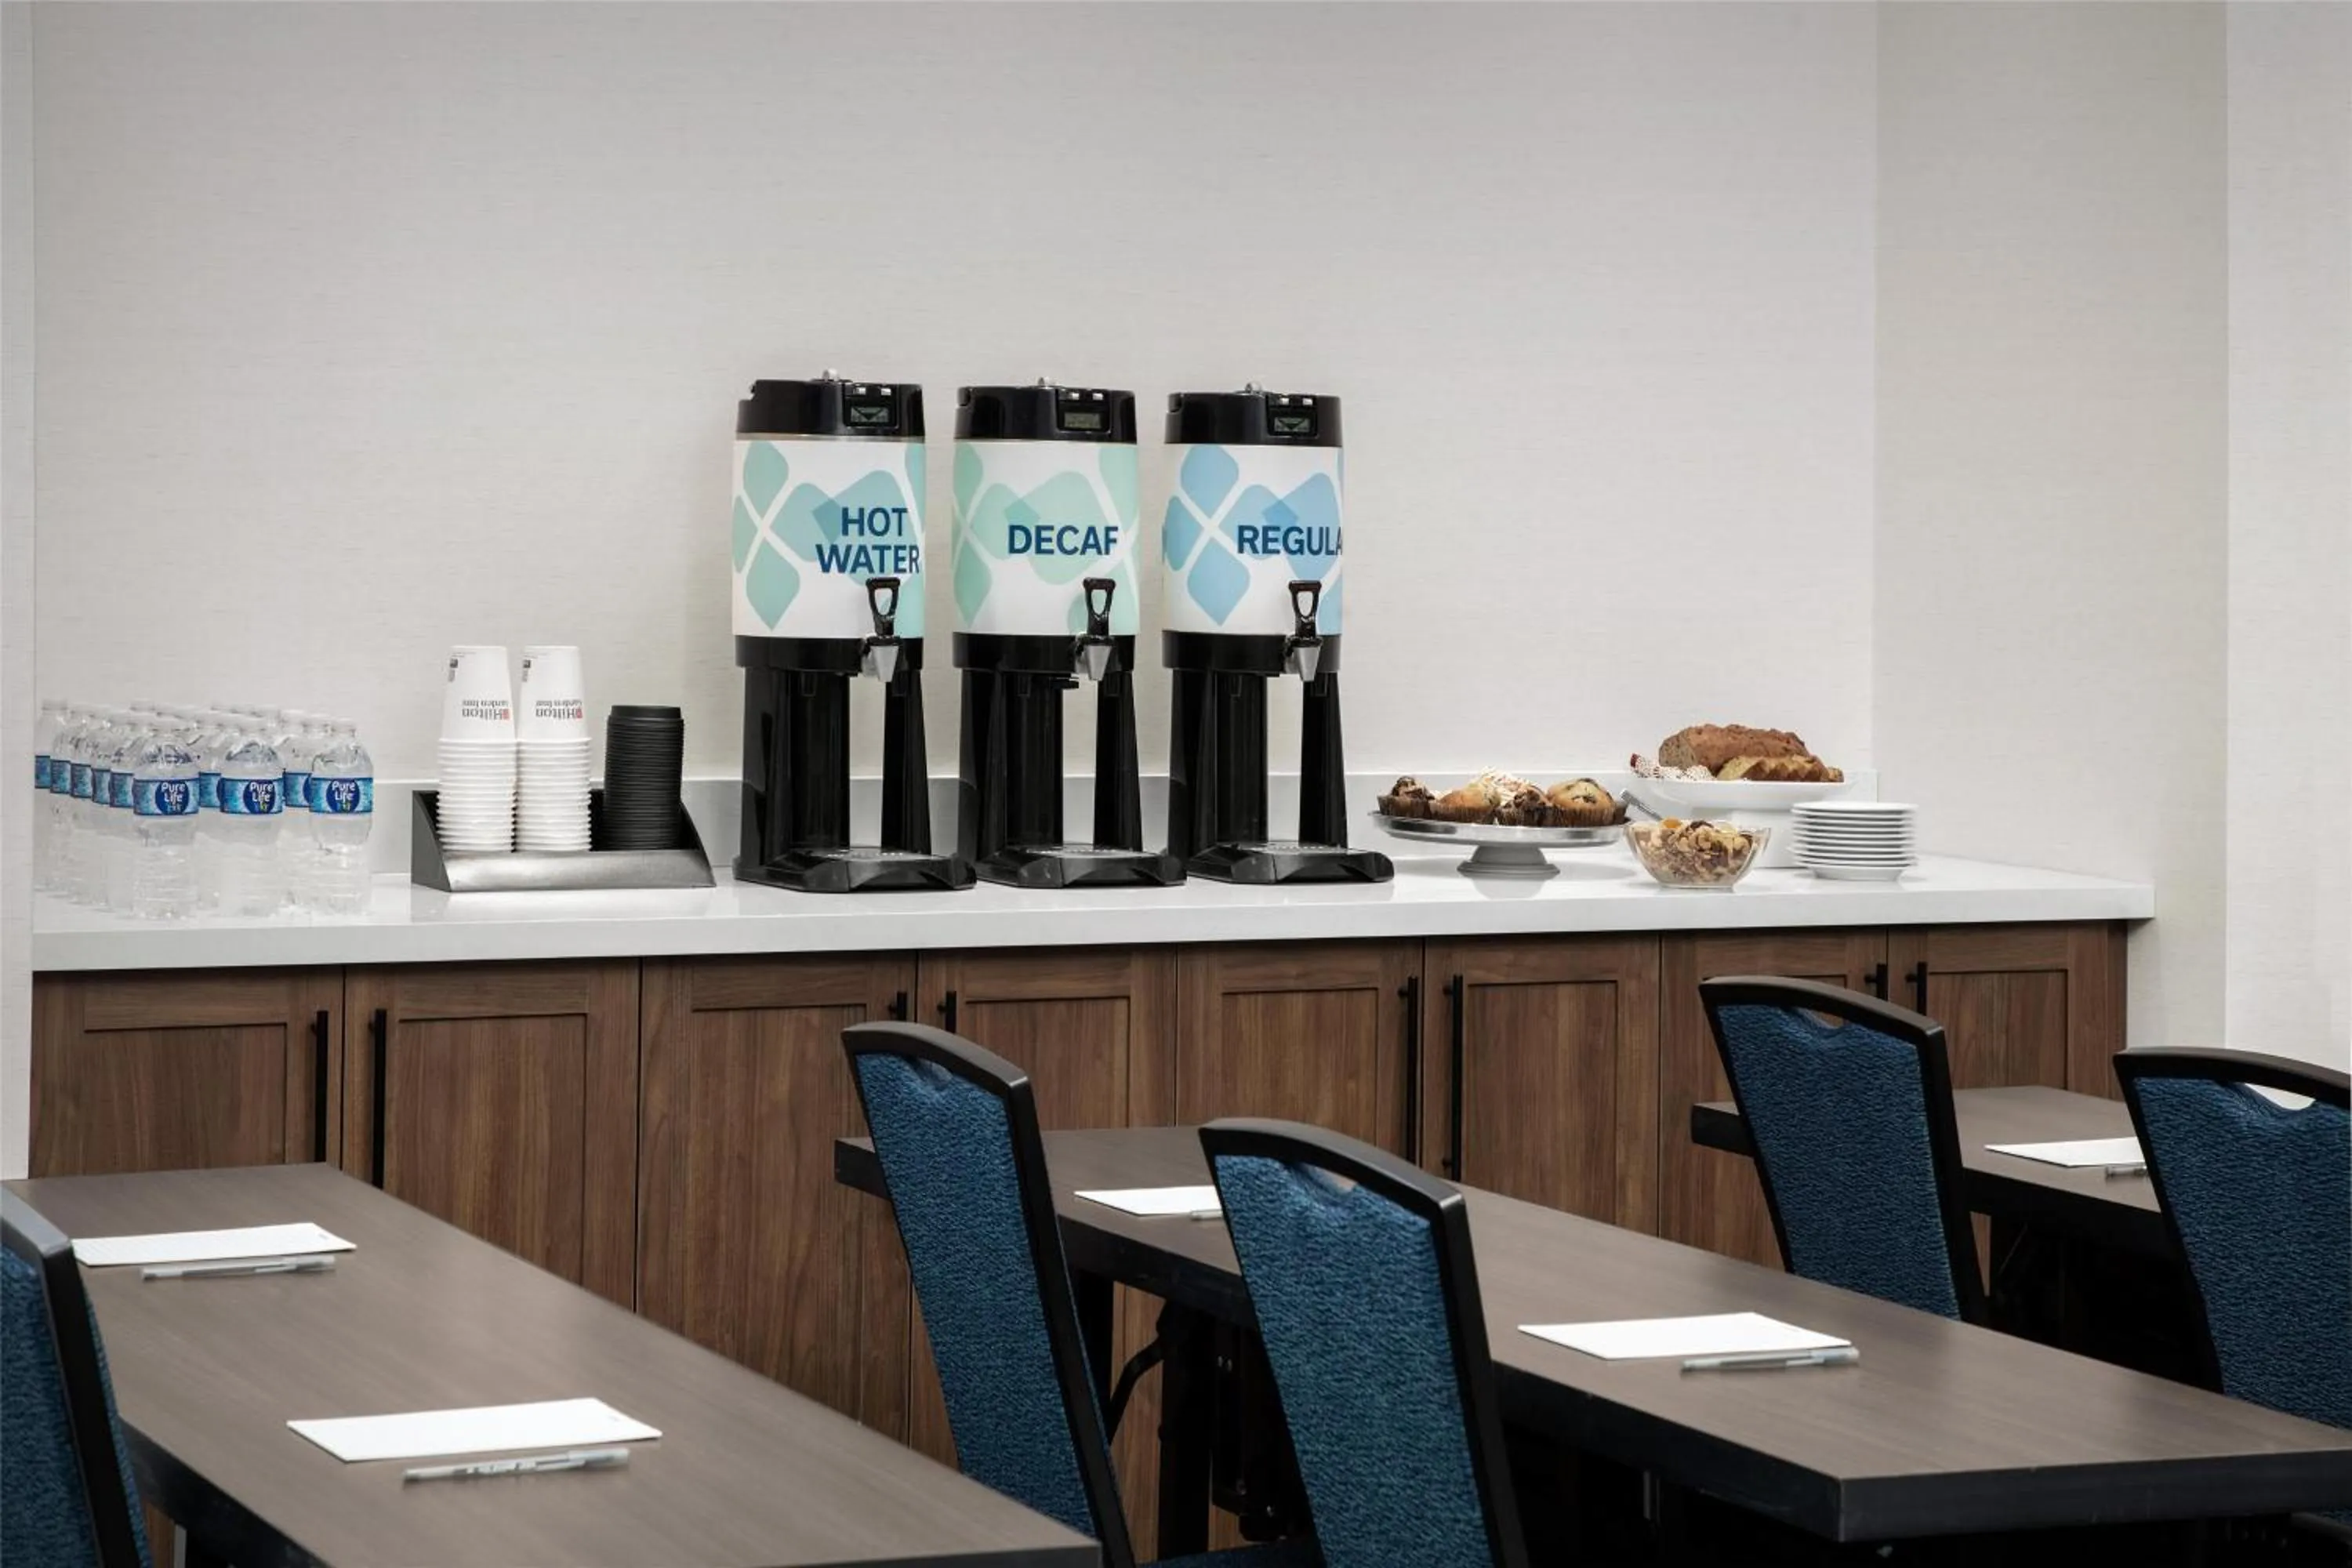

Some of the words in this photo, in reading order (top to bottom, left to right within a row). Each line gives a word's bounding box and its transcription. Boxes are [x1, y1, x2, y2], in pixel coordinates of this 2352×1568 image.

[841, 506, 908, 537] HOT
[1008, 524, 1119, 556] DECAF
[815, 543, 920, 574] WATER
[462, 707, 503, 720] Hilton
[535, 707, 575, 720] Hilton
[161, 782, 186, 793] Pure
[249, 782, 274, 793] Pure
[332, 780, 356, 791] Pure
[164, 792, 183, 805] Life
[252, 791, 271, 805] Life
[335, 790, 354, 804] Life
